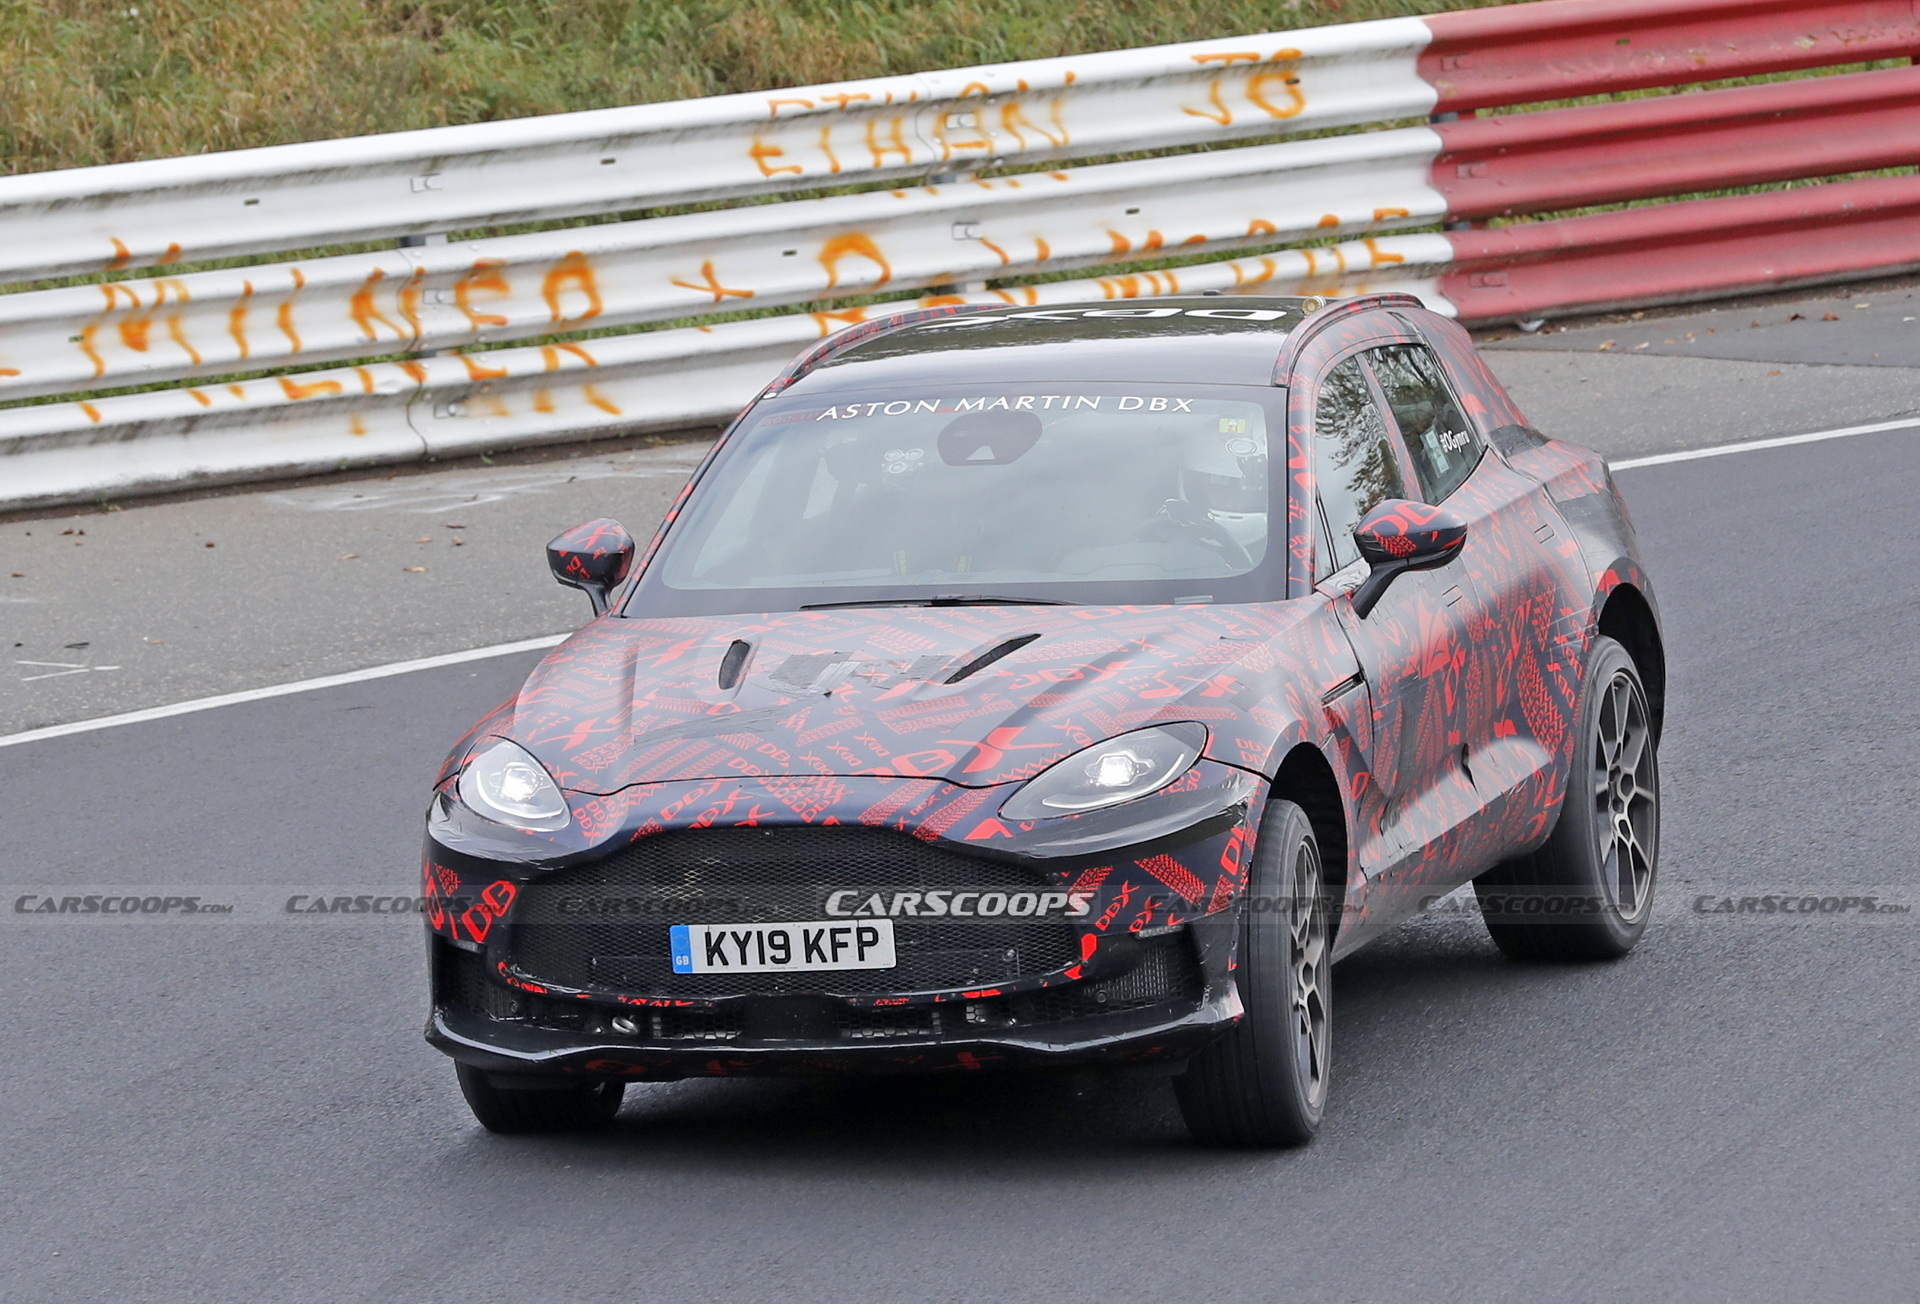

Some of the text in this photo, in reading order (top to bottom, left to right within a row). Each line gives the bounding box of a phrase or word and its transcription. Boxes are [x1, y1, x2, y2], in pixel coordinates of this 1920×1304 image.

[749, 70, 1077, 178] ETHAN
[816, 398, 942, 422] ASTON
[953, 394, 1102, 414] MARTIN
[1117, 395, 1195, 414] DBX
[1095, 880, 1141, 931] DBX
[675, 955, 690, 966] GB
[704, 927, 879, 966] KY19 KFP
